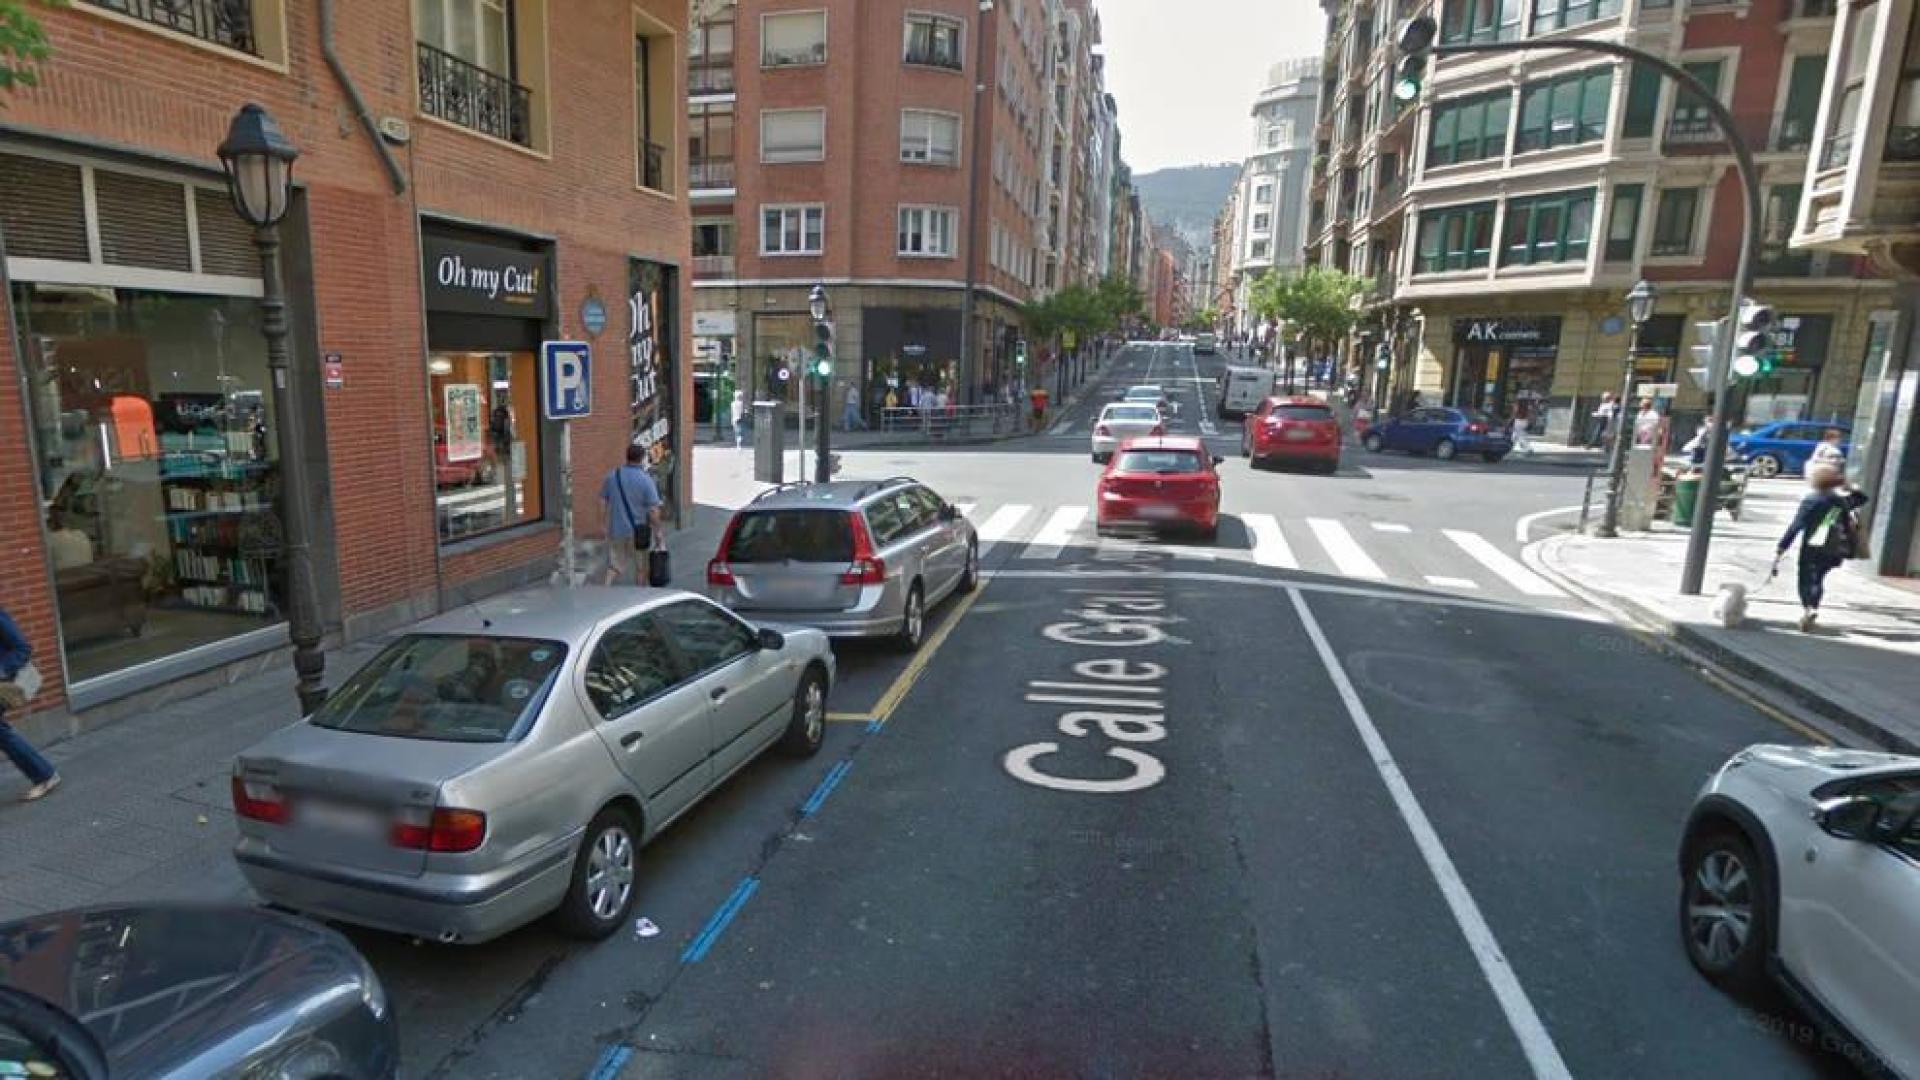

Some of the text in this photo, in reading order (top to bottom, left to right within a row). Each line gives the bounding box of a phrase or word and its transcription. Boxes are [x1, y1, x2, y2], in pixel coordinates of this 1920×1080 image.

[439, 256, 539, 299] Oh my Cut!
[554, 351, 582, 409] P
